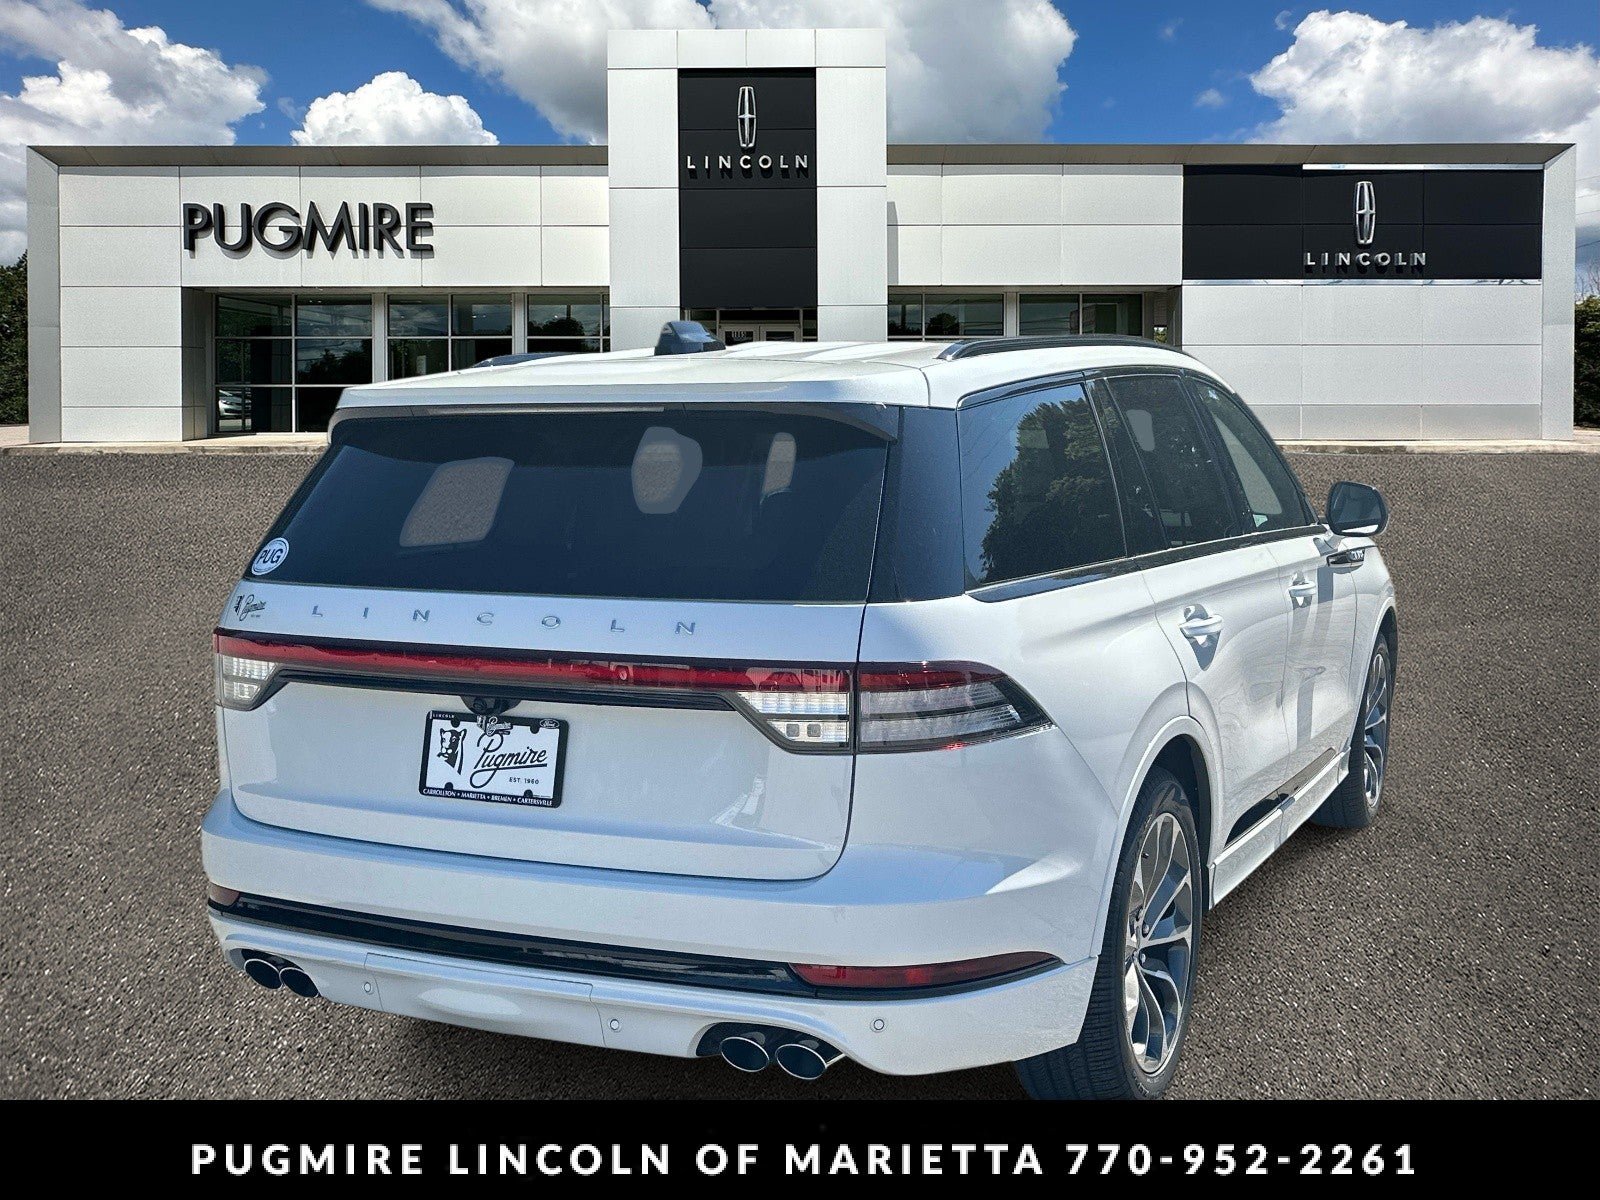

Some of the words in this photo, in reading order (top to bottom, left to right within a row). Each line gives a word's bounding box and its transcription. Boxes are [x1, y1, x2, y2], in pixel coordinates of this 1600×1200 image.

[686, 155, 808, 170] LINCOLN
[183, 201, 434, 253] PUGMIRE
[1304, 252, 1427, 266] LINCOLN
[256, 548, 284, 565] PUG
[311, 604, 697, 636] LINCOLN
[469, 732, 548, 789] Pugmire
[422, 788, 456, 797] CARROLLTON
[461, 792, 486, 800] MARIETTA
[491, 795, 512, 803] BREMEN
[517, 797, 553, 806] CARTERSVILLE
